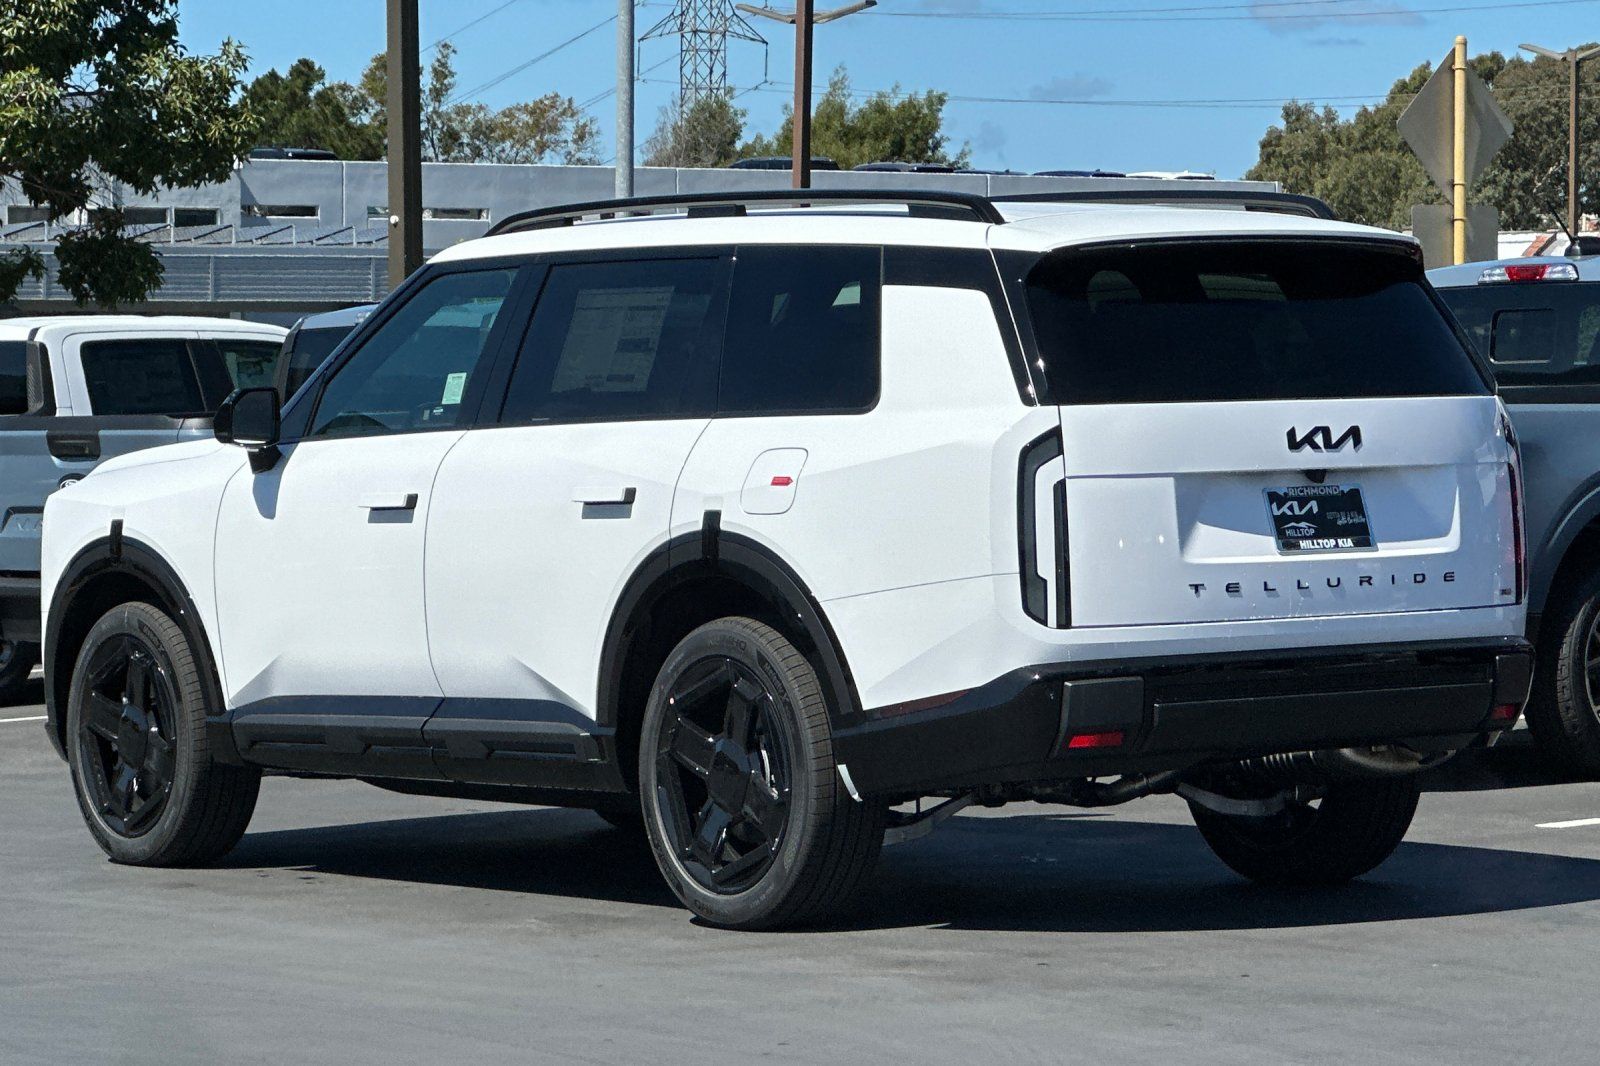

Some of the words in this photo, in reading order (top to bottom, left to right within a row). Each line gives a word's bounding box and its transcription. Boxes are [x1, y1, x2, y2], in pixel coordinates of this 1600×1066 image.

[1286, 425, 1362, 451] KIA
[1288, 486, 1340, 496] RICHMOND
[1271, 500, 1319, 516] KIA
[1285, 528, 1315, 537] HILLTOP
[1299, 539, 1336, 549] HILLTOP
[1337, 538, 1354, 548] KIA
[1188, 571, 1456, 594] TELLURIDE
